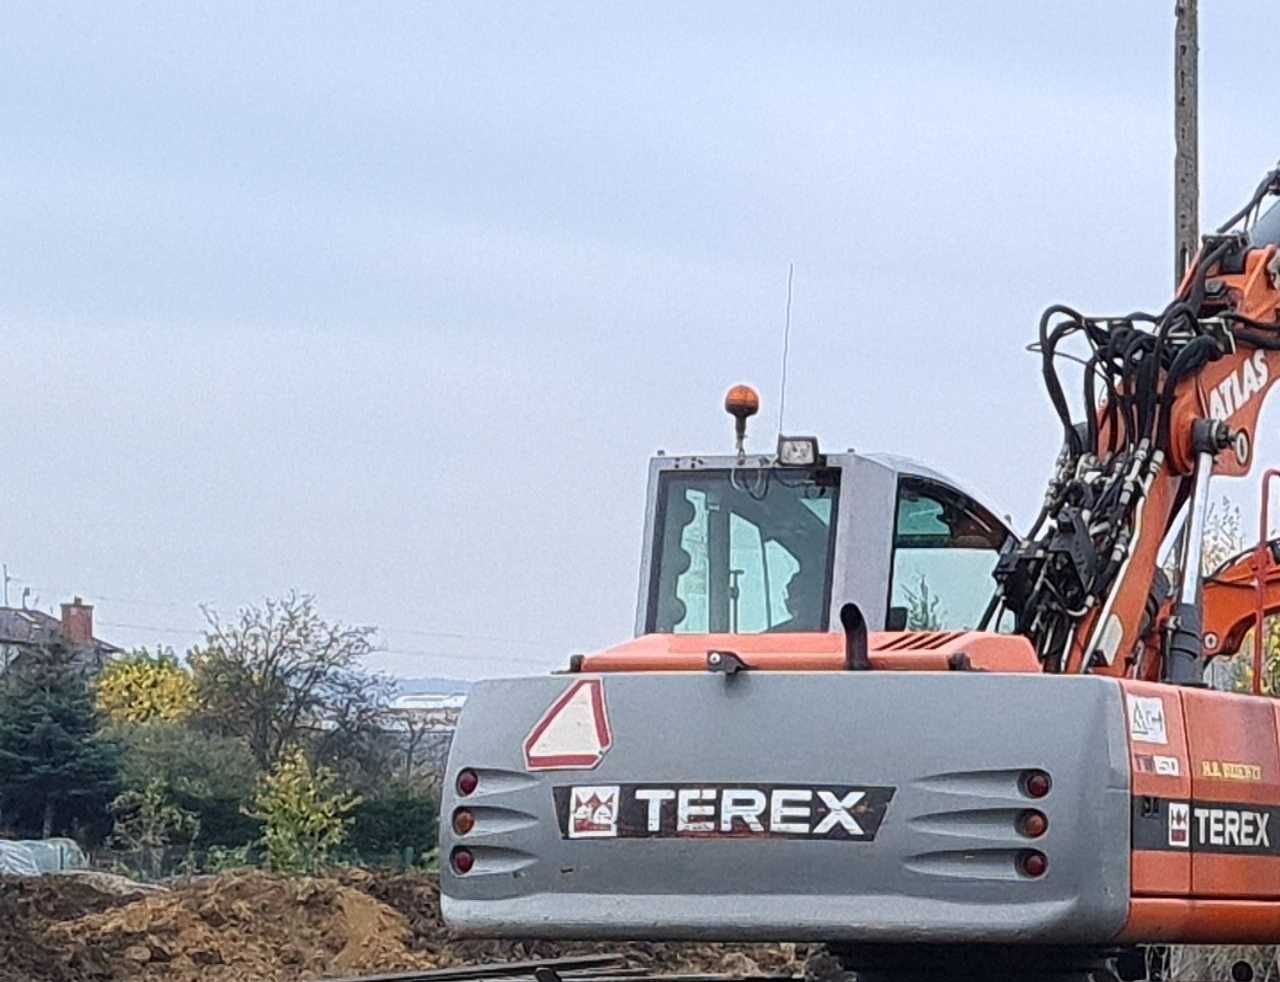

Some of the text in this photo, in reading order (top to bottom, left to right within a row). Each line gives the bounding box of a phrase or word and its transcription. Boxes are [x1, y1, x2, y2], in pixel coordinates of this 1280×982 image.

[1209, 349, 1268, 421] ATLAS
[634, 788, 866, 835] TEREX
[1194, 808, 1270, 847] TEREX
